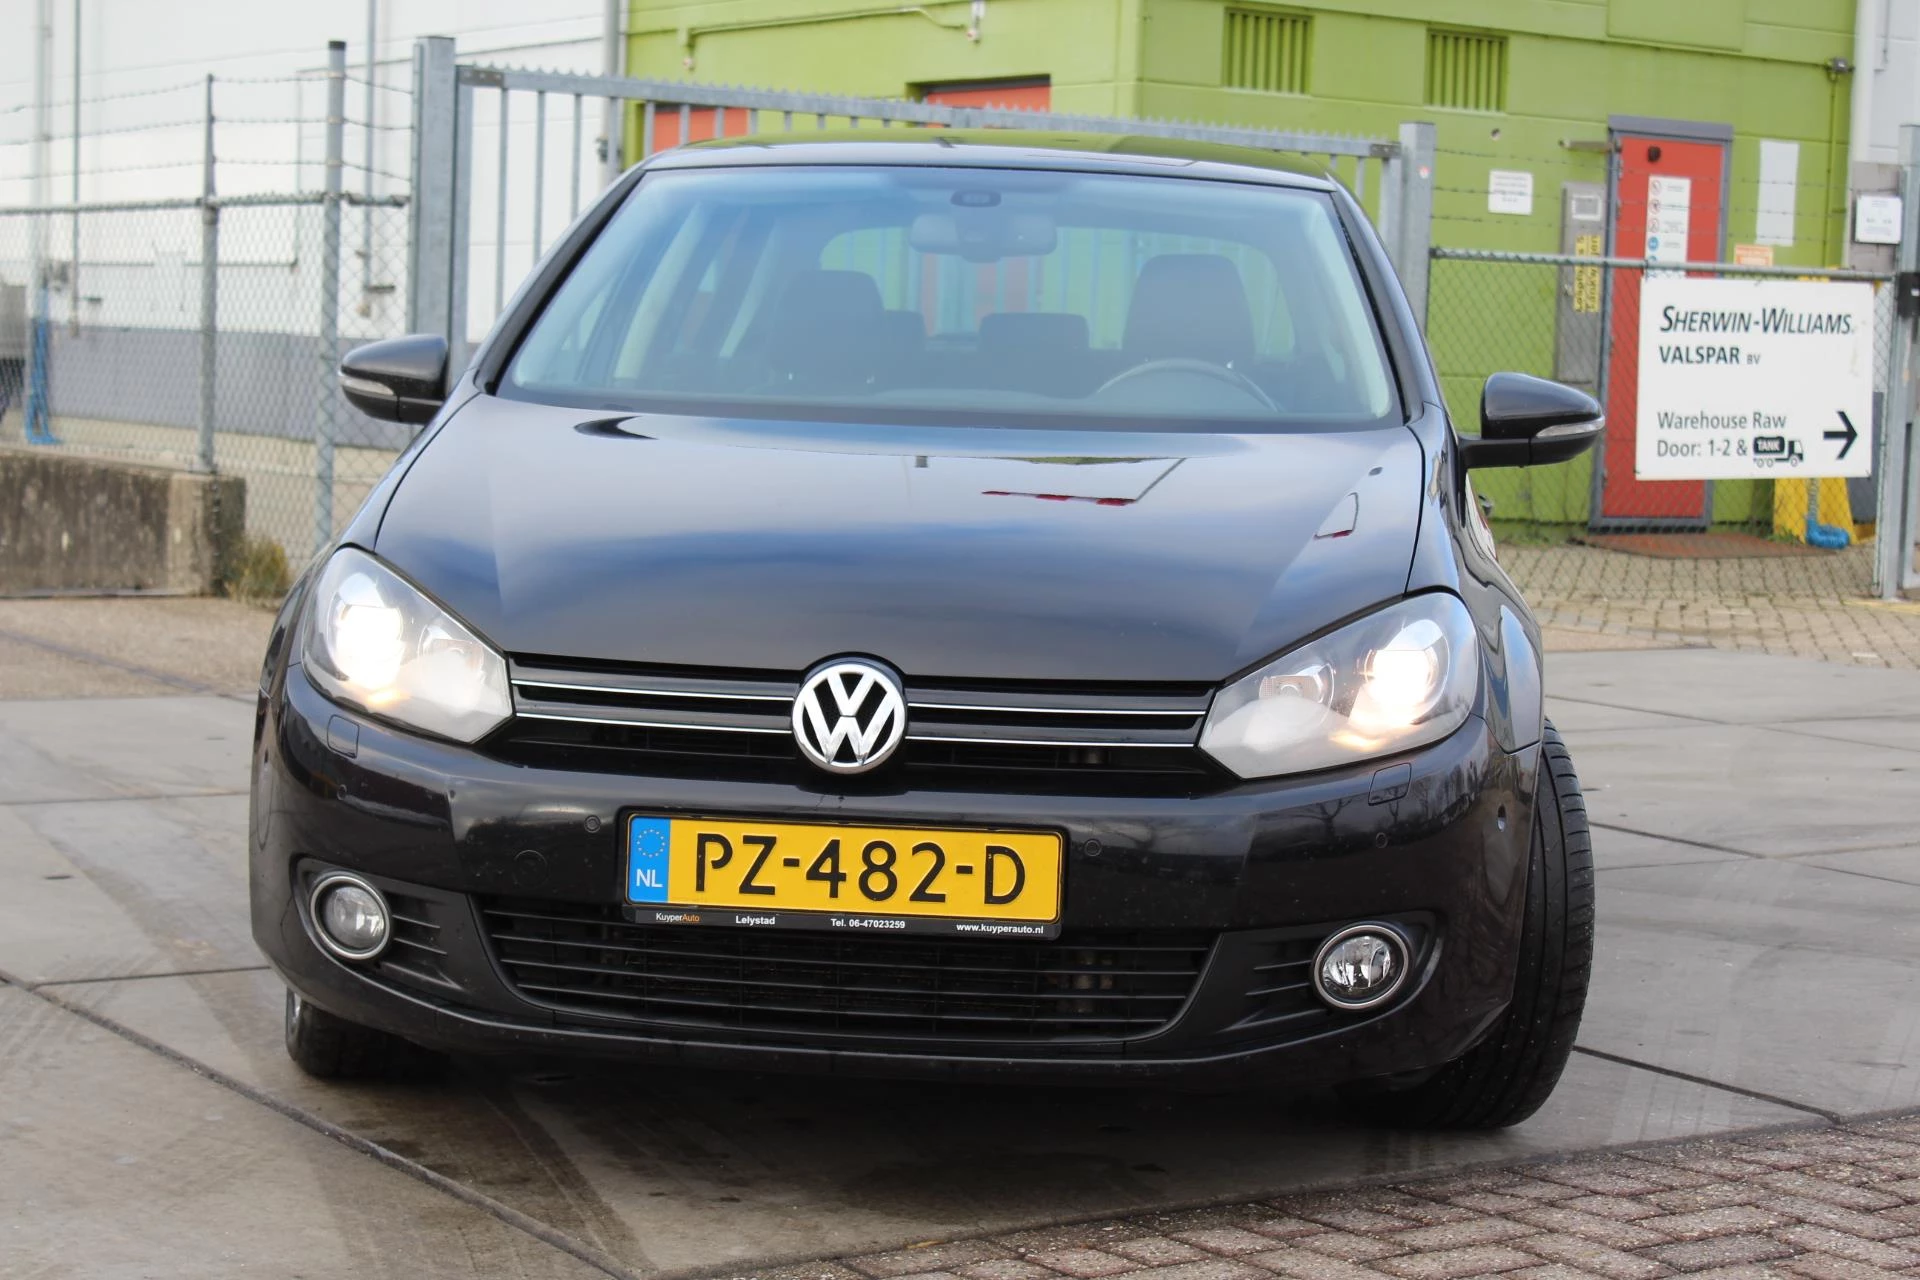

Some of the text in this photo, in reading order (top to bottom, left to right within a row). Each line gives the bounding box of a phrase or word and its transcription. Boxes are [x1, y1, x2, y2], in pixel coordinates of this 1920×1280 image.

[1659, 345, 1761, 366] VALSPAR BV
[1657, 411, 1786, 430] Warehouse Raw
[1657, 439, 1781, 457] Door: 1-2 & TANK
[695, 832, 1027, 906] PZ-482-D
[635, 868, 663, 889] NL
[655, 912, 700, 924] KuyperAuto
[735, 914, 776, 926] Lelystad
[830, 918, 906, 929] Tel. 06-47023259
[956, 922, 1044, 935] www.kuyperauto.nl
